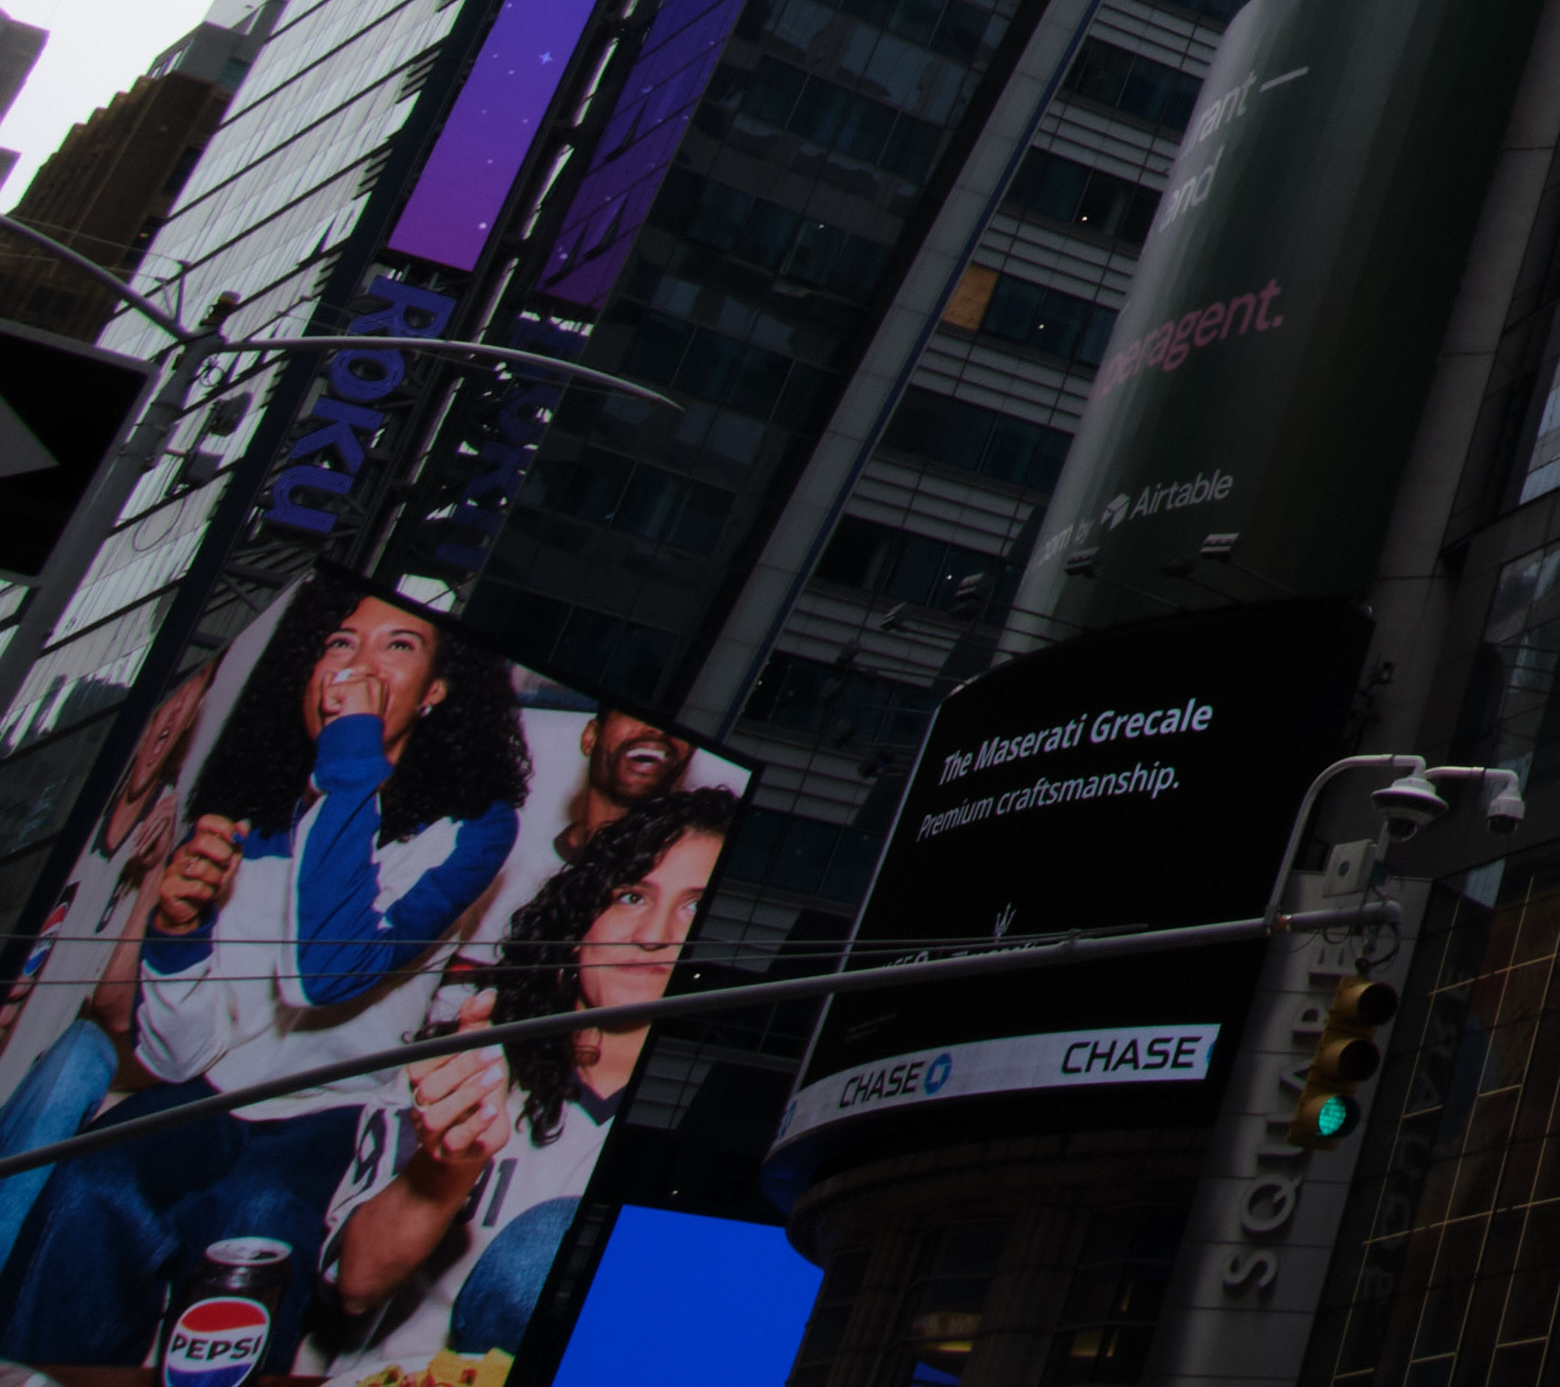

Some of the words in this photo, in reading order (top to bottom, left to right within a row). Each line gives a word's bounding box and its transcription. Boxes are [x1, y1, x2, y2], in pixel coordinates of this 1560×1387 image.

[1129, 468, 1235, 522] Airtable
[938, 747, 973, 787] The
[973, 713, 1088, 773] Maserati
[1089, 697, 1215, 745] Grecale
[916, 797, 995, 844] Premium
[995, 760, 1181, 817] craftsmanship.
[1061, 1036, 1203, 1075] CHASE
[838, 1060, 926, 1109] CHASE
[170, 1333, 265, 1362] PEPSI
